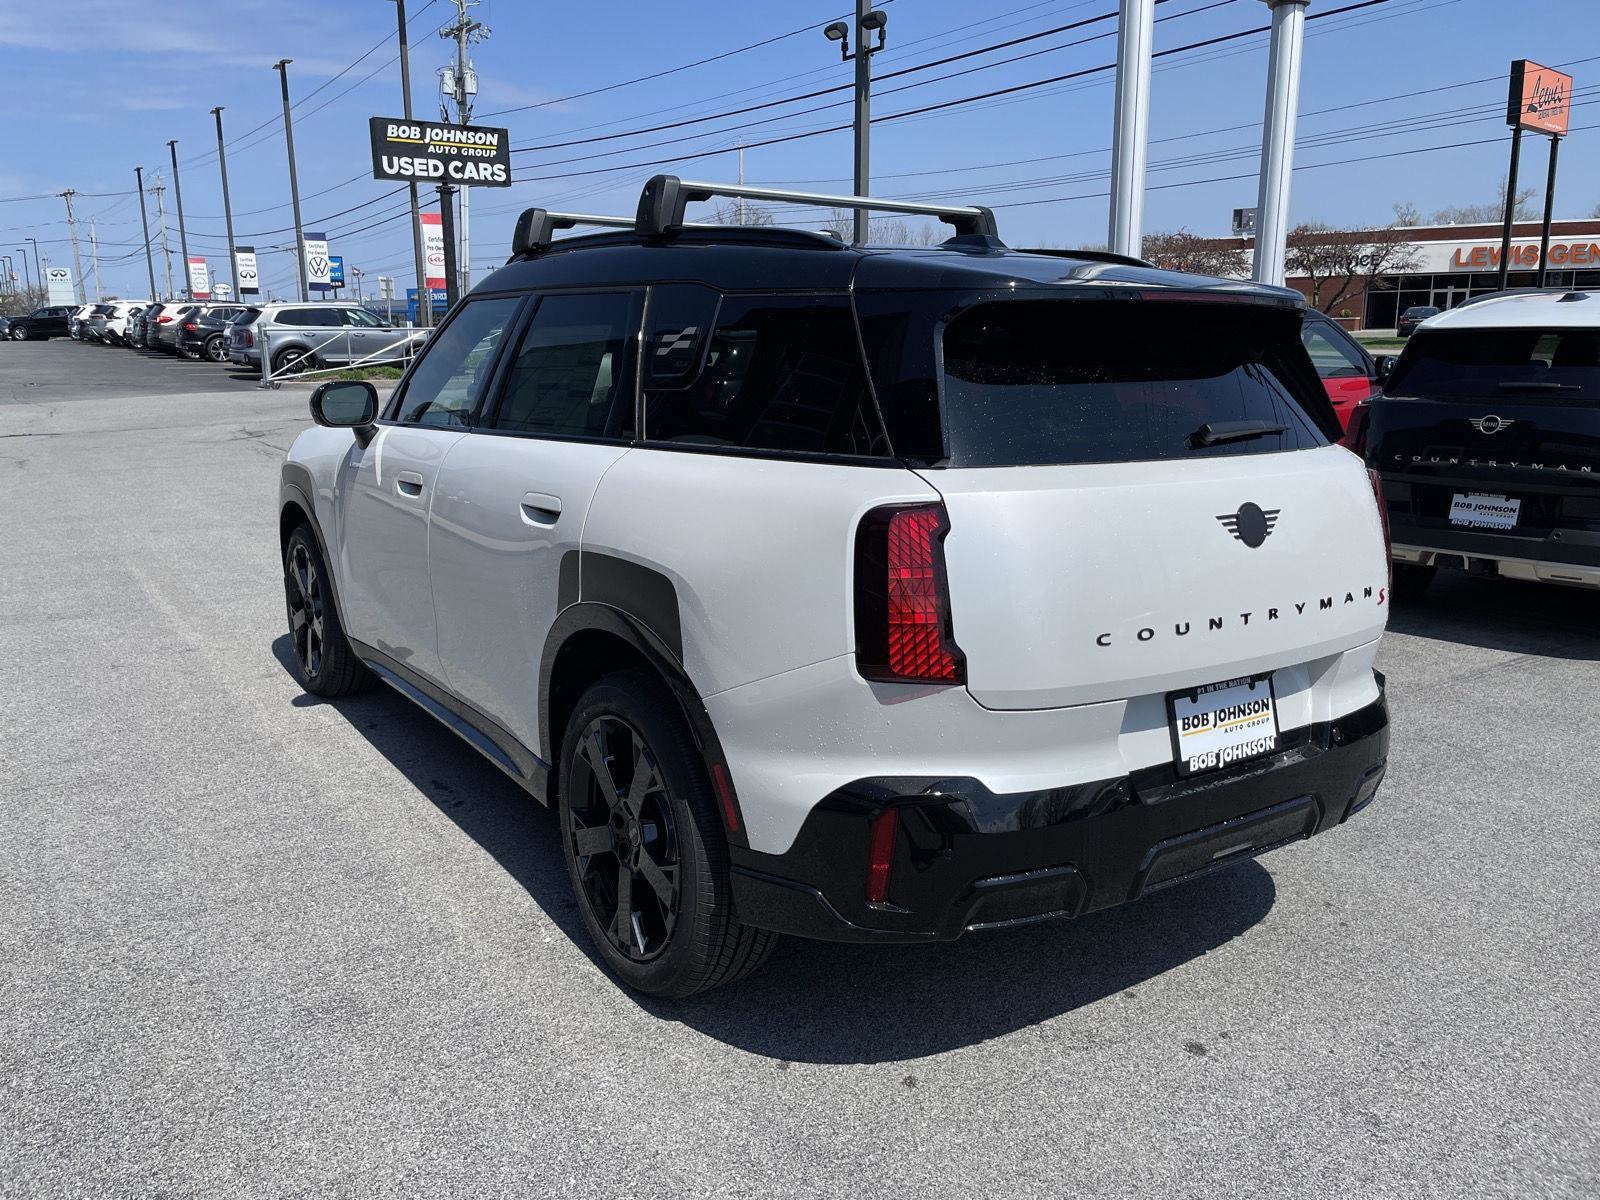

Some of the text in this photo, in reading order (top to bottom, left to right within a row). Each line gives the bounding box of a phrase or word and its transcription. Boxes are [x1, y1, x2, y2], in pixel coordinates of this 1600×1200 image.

[387, 124, 498, 146] BOB JOHNSON
[427, 145, 497, 158] AUTO GROUP
[381, 155, 507, 182] USED CARS
[1394, 454, 1591, 472] COUNTRYMAN
[1454, 501, 1517, 514] BOB JOHNSON
[1470, 520, 1513, 530] JOHNSON
[1096, 586, 1372, 647] COUNTRYMAN
[1206, 685, 1214, 693] IN
[1215, 681, 1229, 691] THE
[1228, 677, 1251, 688] NATION
[1182, 698, 1270, 732] BOB JOHNSON
[1224, 717, 1270, 733] AUTO GROUP
[1189, 736, 1275, 772] BOB JOHNSON
